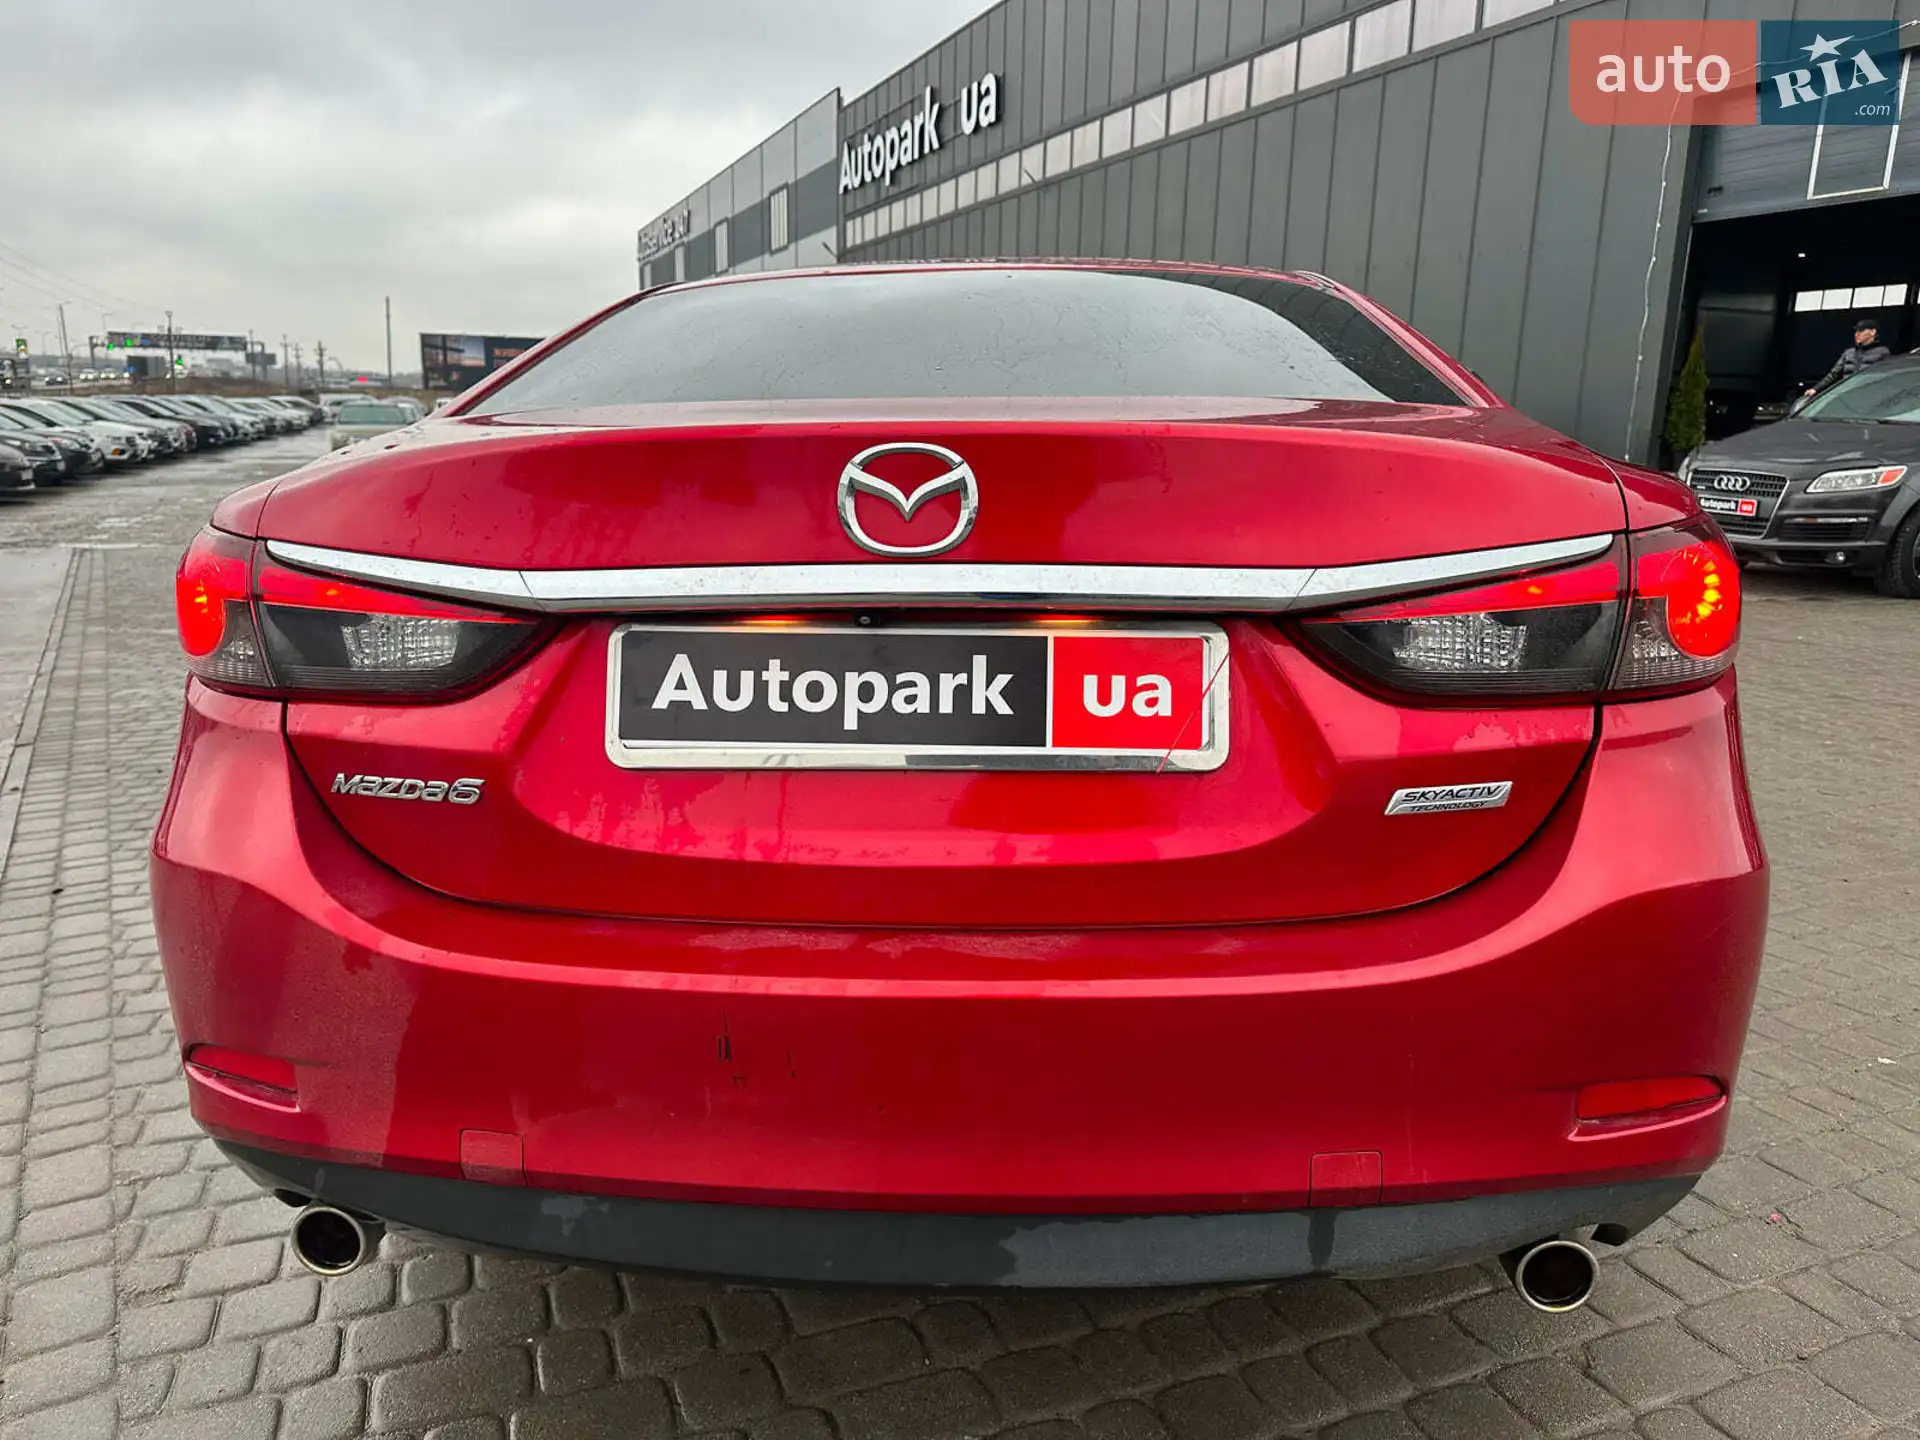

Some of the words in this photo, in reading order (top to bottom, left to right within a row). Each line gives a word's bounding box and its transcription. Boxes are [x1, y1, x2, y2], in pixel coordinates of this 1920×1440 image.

[839, 85, 940, 195] Autopark
[961, 72, 997, 136] ua
[651, 652, 1015, 730] Autopark
[1082, 671, 1173, 719] ua
[1401, 785, 1501, 802] SKYACTIV
[1410, 800, 1488, 812] TECHNOLOGY
